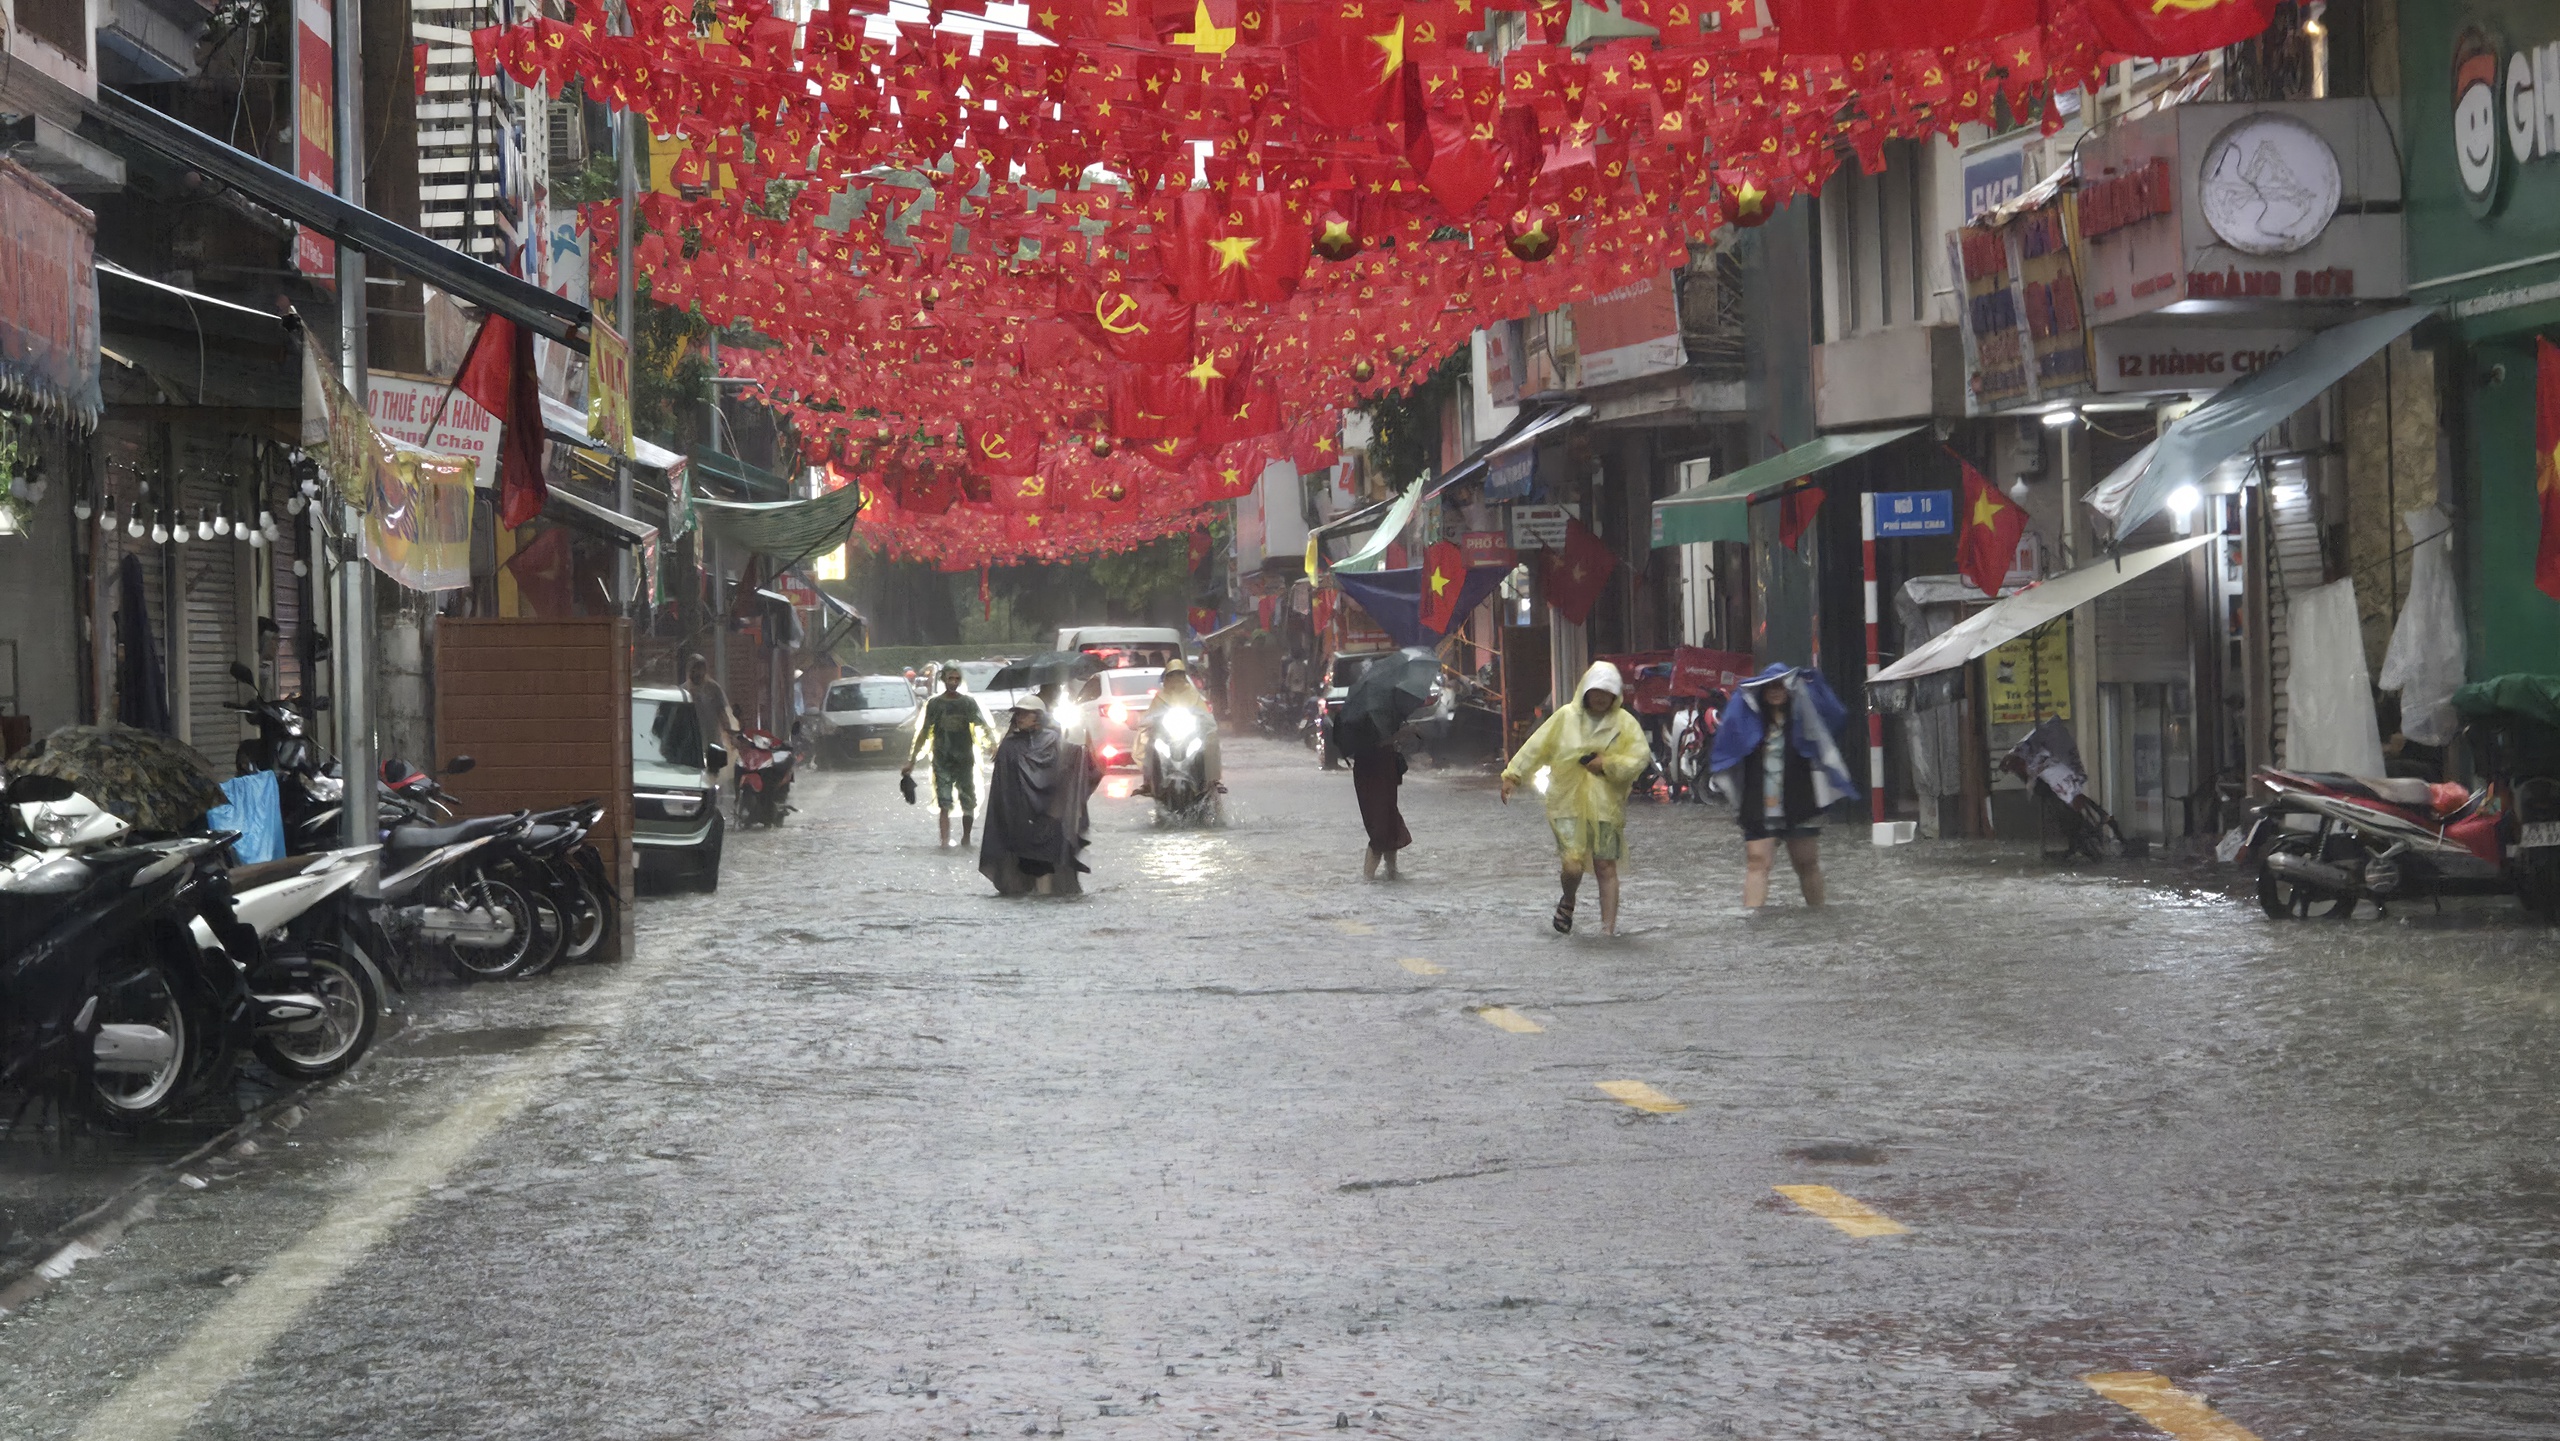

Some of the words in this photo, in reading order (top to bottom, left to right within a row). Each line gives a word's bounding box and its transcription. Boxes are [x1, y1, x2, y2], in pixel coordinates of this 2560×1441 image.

[2118, 355, 2142, 377] 12
[2149, 347, 2225, 375] HÀNG
[382, 388, 417, 423] THUÊ
[436, 433, 484, 451] Cháo
